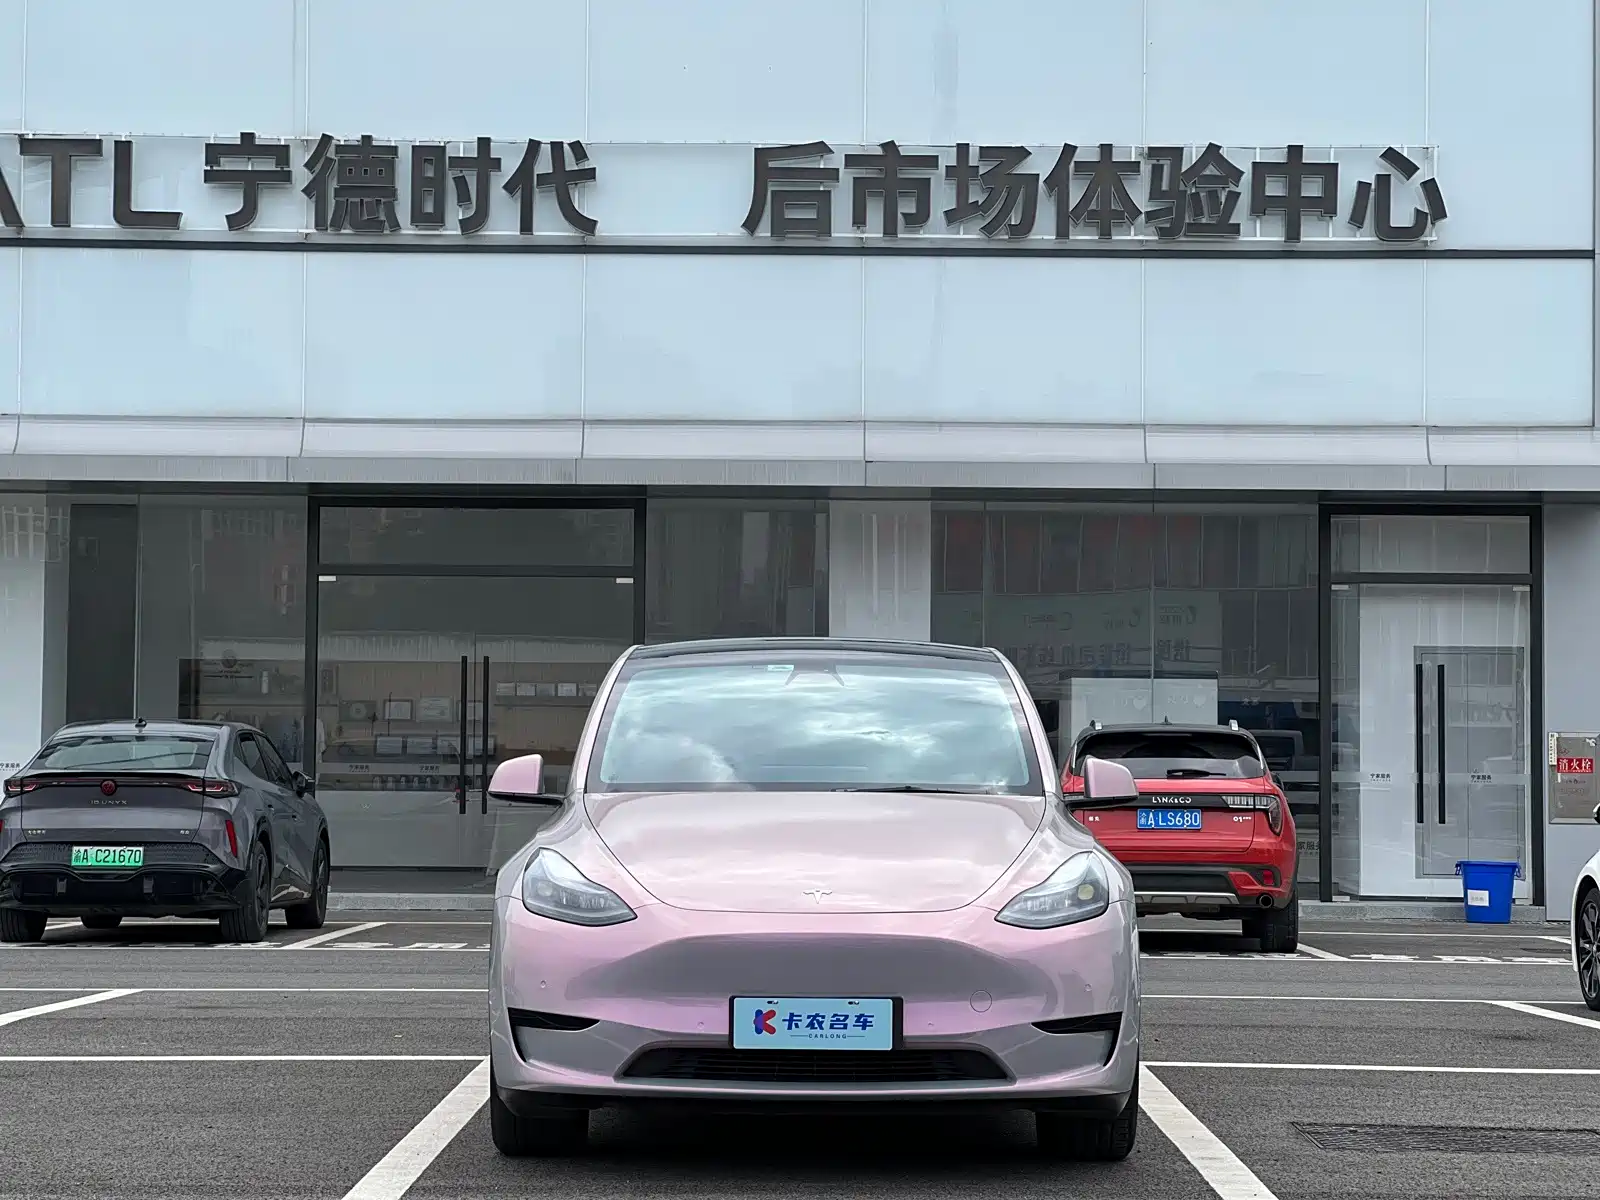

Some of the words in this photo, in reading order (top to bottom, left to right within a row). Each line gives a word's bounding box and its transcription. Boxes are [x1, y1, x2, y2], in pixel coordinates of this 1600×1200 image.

[204, 131, 598, 236] 宁德时代
[741, 140, 1448, 243] 后市场体验中心
[1559, 758, 1592, 771] 消火栓
[781, 1012, 874, 1031] 卡农名车
